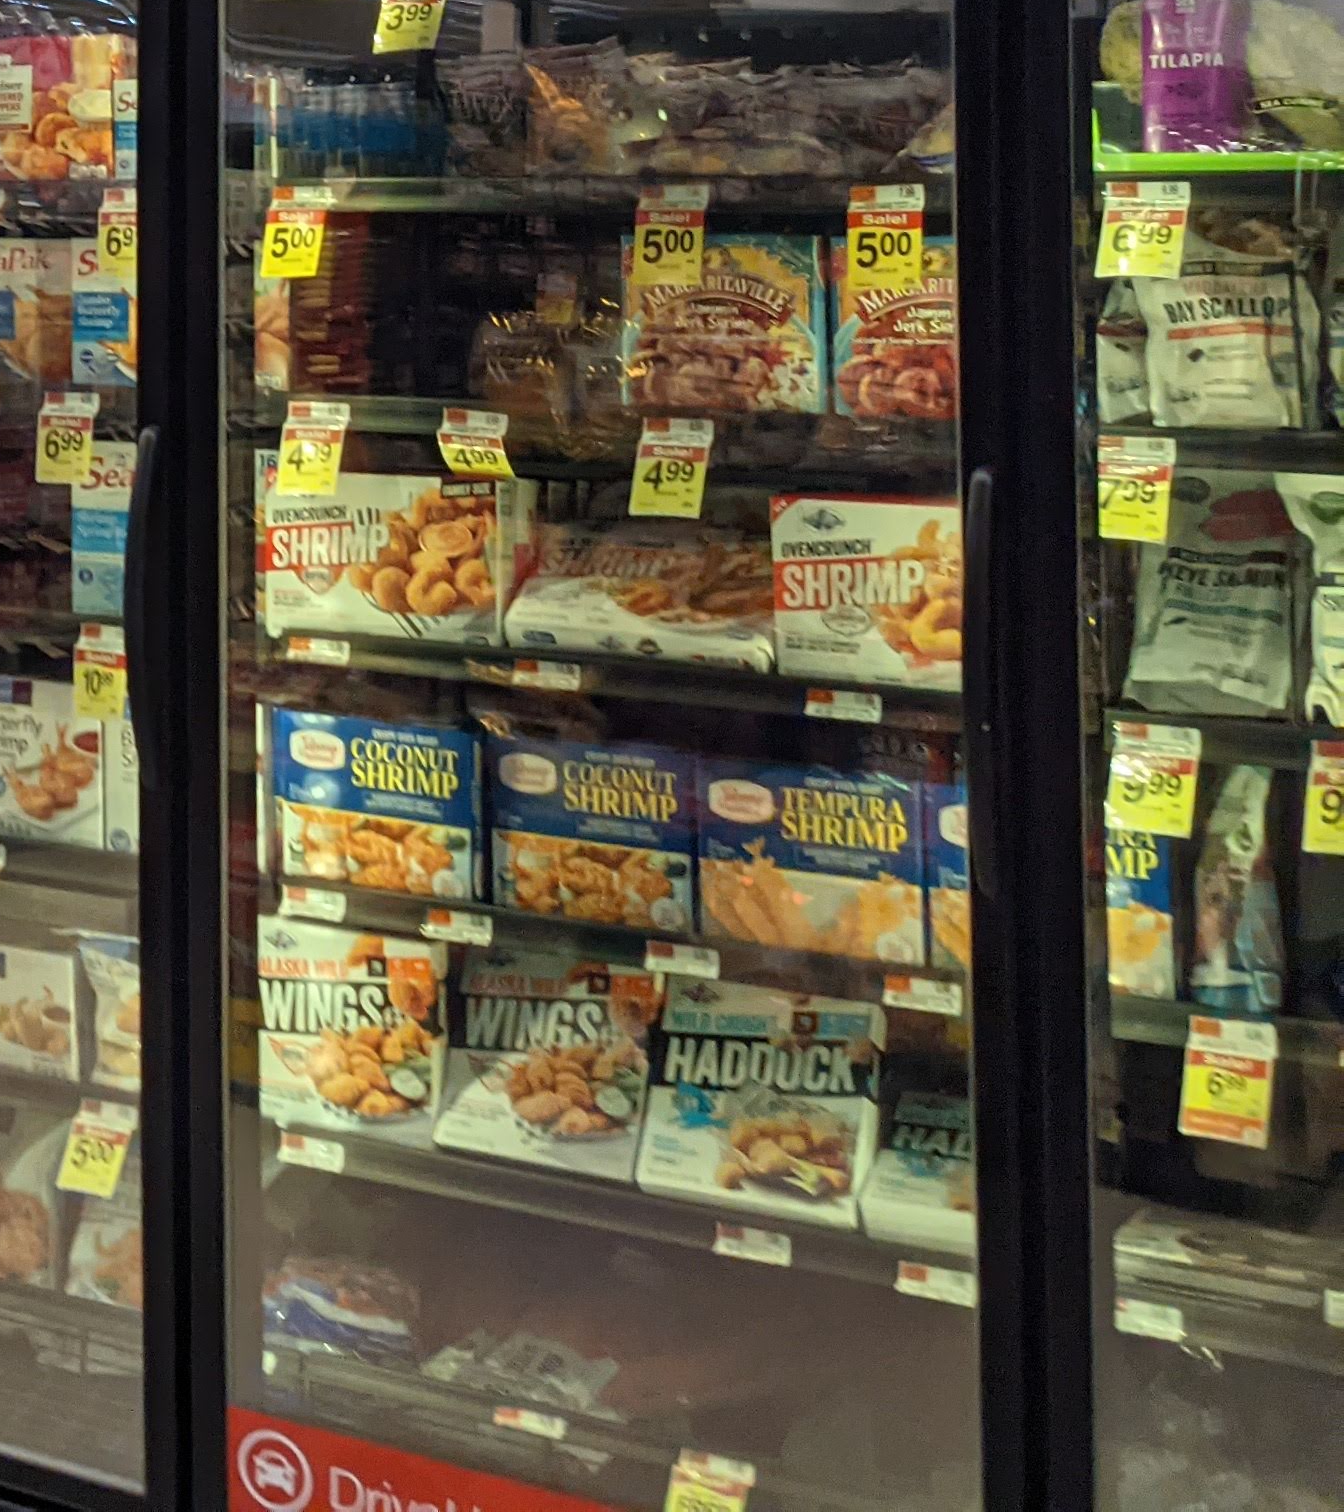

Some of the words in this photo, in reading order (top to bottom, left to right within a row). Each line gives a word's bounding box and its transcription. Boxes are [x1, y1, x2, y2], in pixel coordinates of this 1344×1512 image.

[384, 3, 433, 31] 399
[1148, 51, 1224, 69] TILAPIA
[861, 212, 909, 227] Sale!
[105, 226, 135, 257] 69
[269, 226, 316, 258] 500
[642, 229, 695, 265] 500
[855, 231, 913, 269] 500
[1112, 223, 1173, 256] 699
[644, 273, 792, 314] MARRITAVILLE
[1199, 295, 1293, 321] SCALLOP
[45, 428, 84, 459] 699
[82, 456, 134, 490] Sea
[642, 461, 696, 493] 499
[272, 506, 348, 525] OVENCRUNCH
[270, 524, 391, 569] SHRIMP
[780, 537, 873, 558] OVENCRUNCH
[781, 559, 926, 611] SHRIMP
[349, 736, 460, 773] COCONUT
[349, 760, 460, 801] SHRIMP
[562, 759, 677, 795] COCONUT
[562, 779, 679, 823] SHRIMP
[780, 786, 907, 826] TEMPURA
[780, 810, 909, 854] SHRIMP
[258, 977, 386, 1034] WINGS
[465, 996, 605, 1049] WINGS
[663, 1036, 857, 1094] HADDOCK
